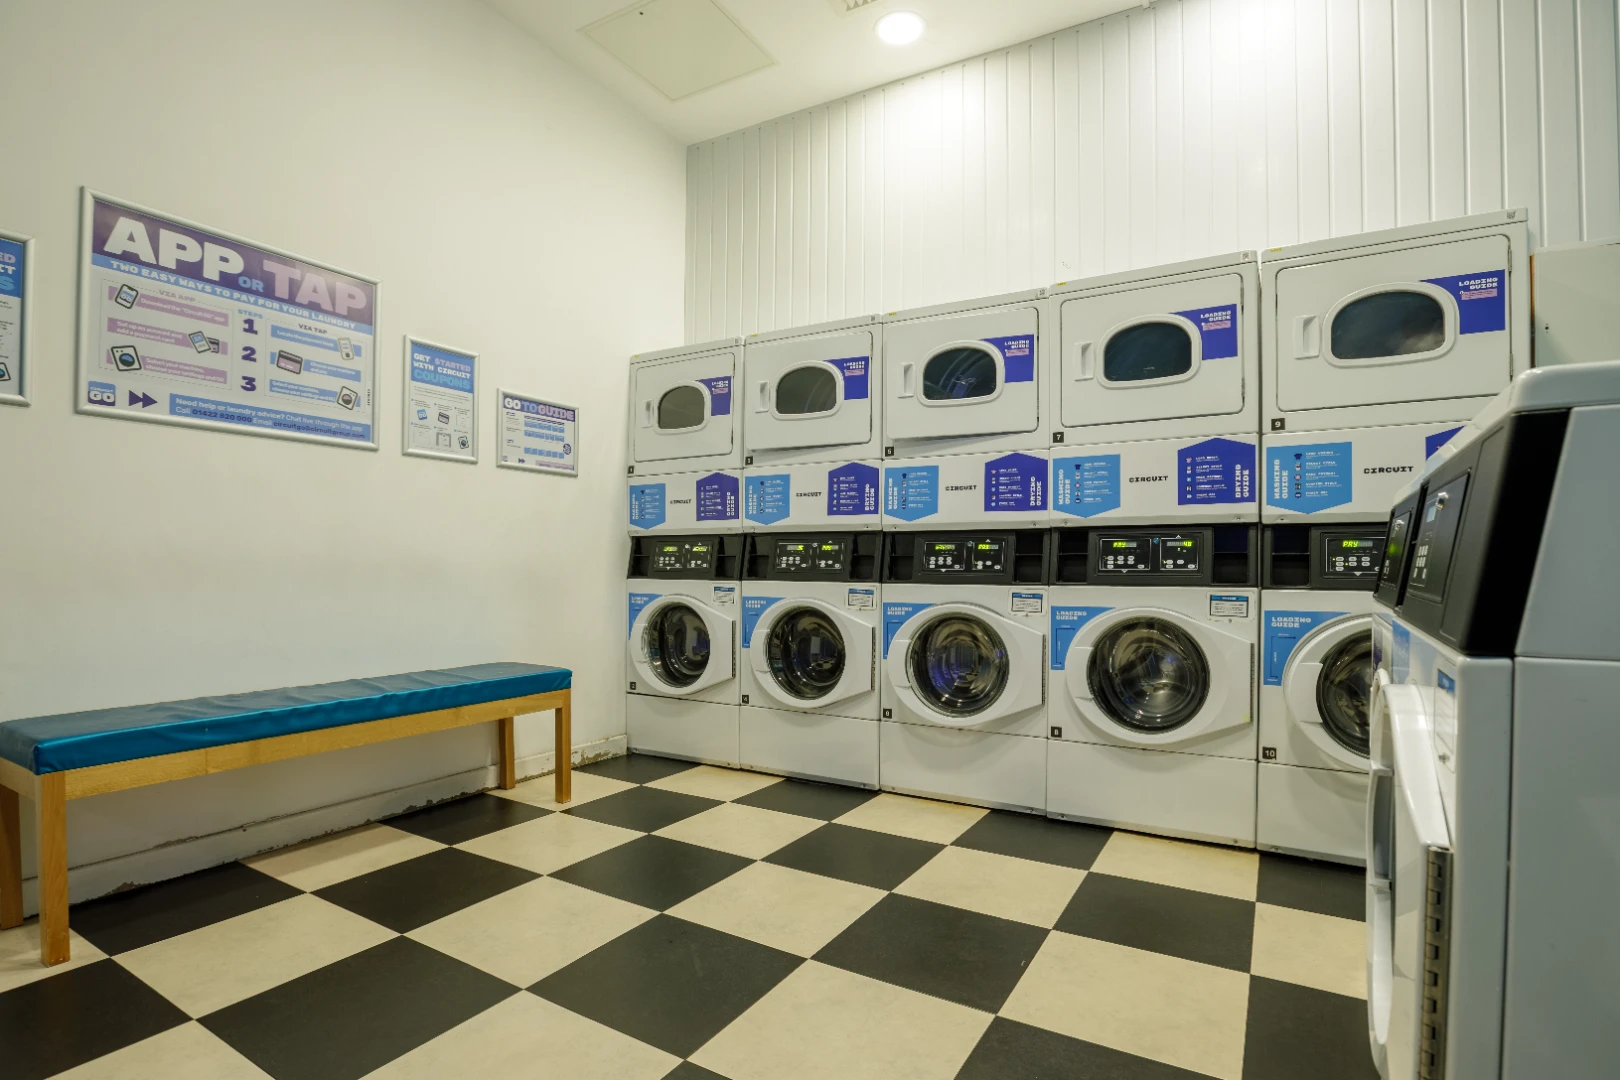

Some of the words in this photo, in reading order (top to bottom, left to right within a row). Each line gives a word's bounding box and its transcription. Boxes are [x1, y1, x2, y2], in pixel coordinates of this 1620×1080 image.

[103, 216, 244, 282] APP
[238, 275, 264, 293] OR
[263, 259, 367, 316] TAP
[1459, 277, 1498, 286] LOADING
[110, 260, 138, 275] TWO
[141, 268, 176, 284] EASY
[179, 278, 212, 292] WAYS
[215, 287, 230, 297] TO
[234, 292, 255, 305] PAY
[258, 299, 280, 310] FOR
[282, 304, 310, 318] YOUR
[312, 312, 356, 329] LAUNDRY
[159, 290, 176, 298] VIA
[237, 309, 263, 319] STEPS
[1201, 310, 1231, 319] LOADING
[242, 318, 258, 335] 1
[241, 346, 257, 363] 2
[414, 353, 430, 362] GET
[434, 358, 471, 372] STARTED
[413, 361, 434, 371] WITH
[438, 366, 471, 379] CIRCUIT
[240, 376, 256, 392] 3
[414, 369, 471, 390] COUPONS
[90, 390, 114, 402] GO
[176, 398, 197, 406] Need
[198, 401, 217, 410] help
[227, 406, 256, 416] laundry
[257, 411, 284, 419] advice?
[285, 414, 302, 422] Chat
[314, 419, 340, 428] through
[192, 409, 218, 418] 01422
[253, 418, 272, 426] Email
[504, 398, 521, 409] GO
[521, 401, 537, 412] TO
[538, 405, 574, 420] GUIDE
[1363, 466, 1414, 474] CIRCUIT
